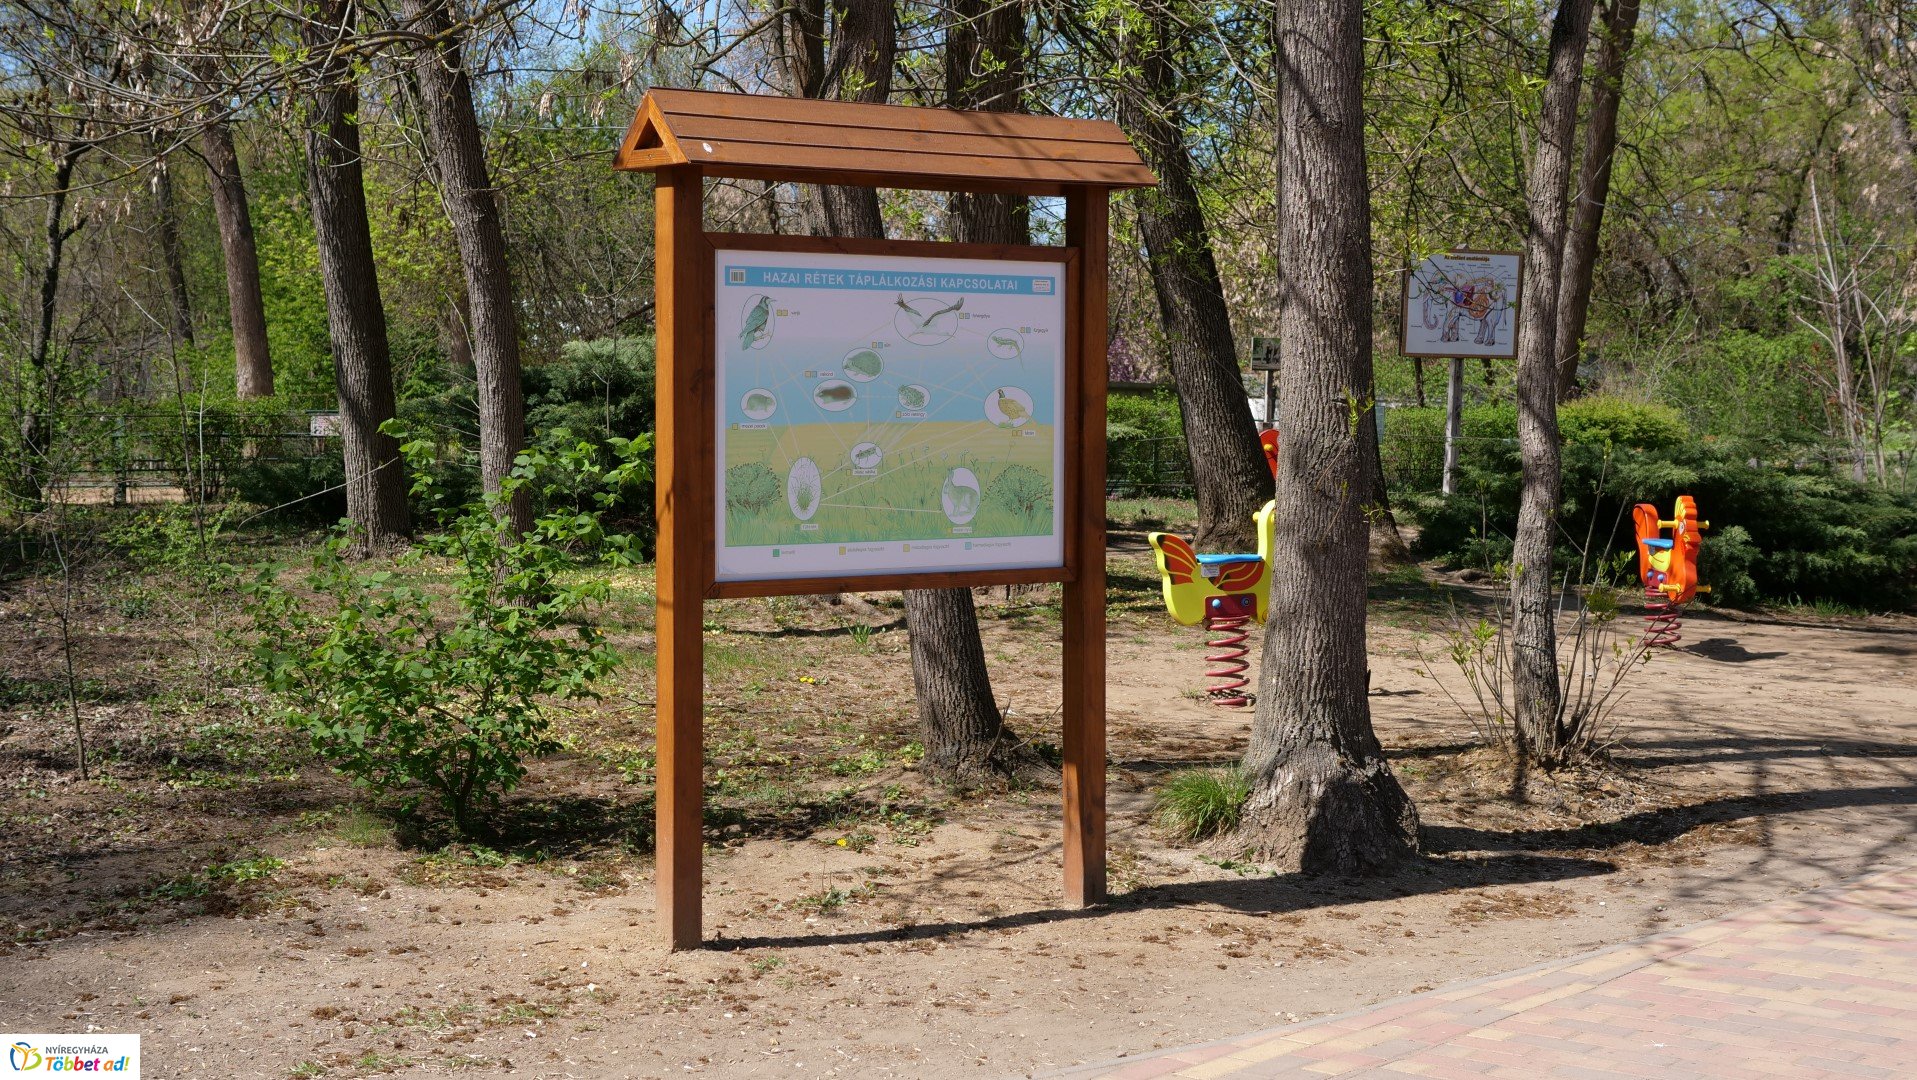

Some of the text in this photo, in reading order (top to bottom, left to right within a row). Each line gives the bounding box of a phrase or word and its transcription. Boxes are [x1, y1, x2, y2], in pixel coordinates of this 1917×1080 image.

[763, 271, 800, 284] HAZAI
[804, 271, 844, 285] RÉTEK
[849, 272, 937, 288] TÁPLÁLKOZÁSI
[940, 278, 1018, 290] KAPCSOLATAI
